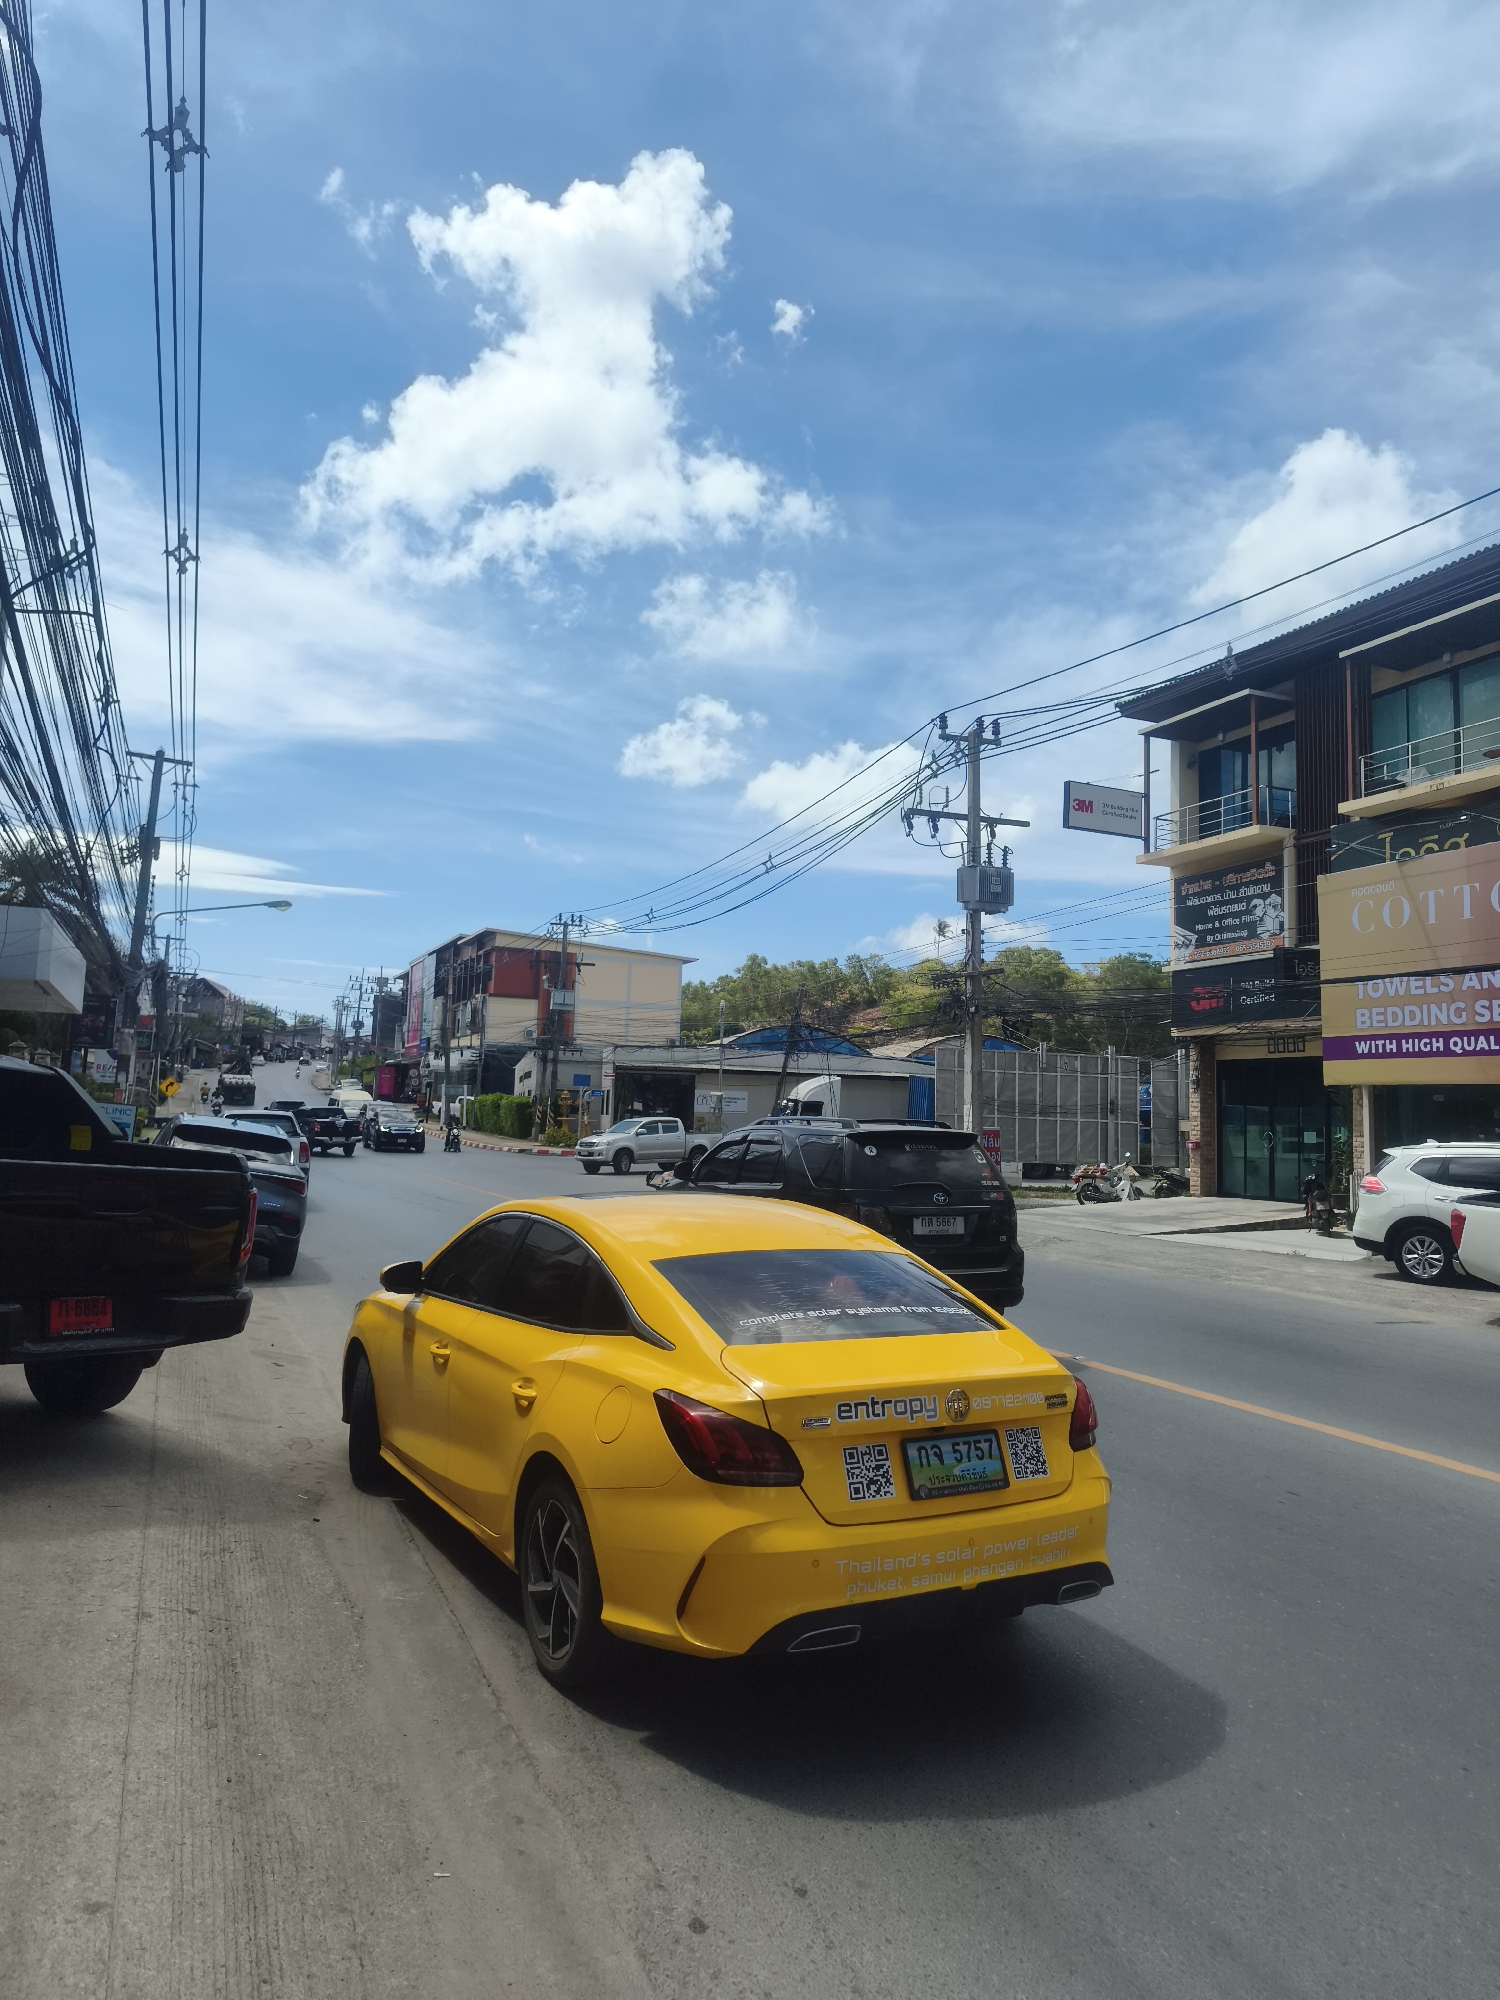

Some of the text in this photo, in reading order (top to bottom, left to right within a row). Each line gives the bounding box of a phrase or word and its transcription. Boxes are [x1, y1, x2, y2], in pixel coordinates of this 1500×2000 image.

[1072, 798, 1094, 814] 3M
[1102, 810, 1122, 818] Certified
[1111, 804, 1129, 813] Building
[1195, 914, 1259, 931] Home & Office Films
[1206, 934, 1214, 943] By
[1354, 975, 1455, 1000] TOWELS
[1240, 992, 1275, 1006] Certified
[1355, 1001, 1468, 1029] BEDDING
[1355, 1039, 1397, 1054] WITH
[1402, 1037, 1444, 1053] HIGH
[936, 1216, 957, 1227] 5667
[739, 1310, 806, 1327] complete
[807, 1308, 842, 1318] solar
[845, 1304, 901, 1316] systems
[900, 1304, 932, 1313] from
[836, 1394, 939, 1423] entropy
[972, 1391, 1046, 1410] 0877221100
[916, 1437, 994, 1468] กจ 5757
[928, 1466, 989, 1486] ประจวบคีรีขันธ์
[835, 1525, 1080, 1575] Thailand's solar power leader
[845, 1575, 907, 1599] phuket,
[1029, 1547, 1071, 1566] huahin
